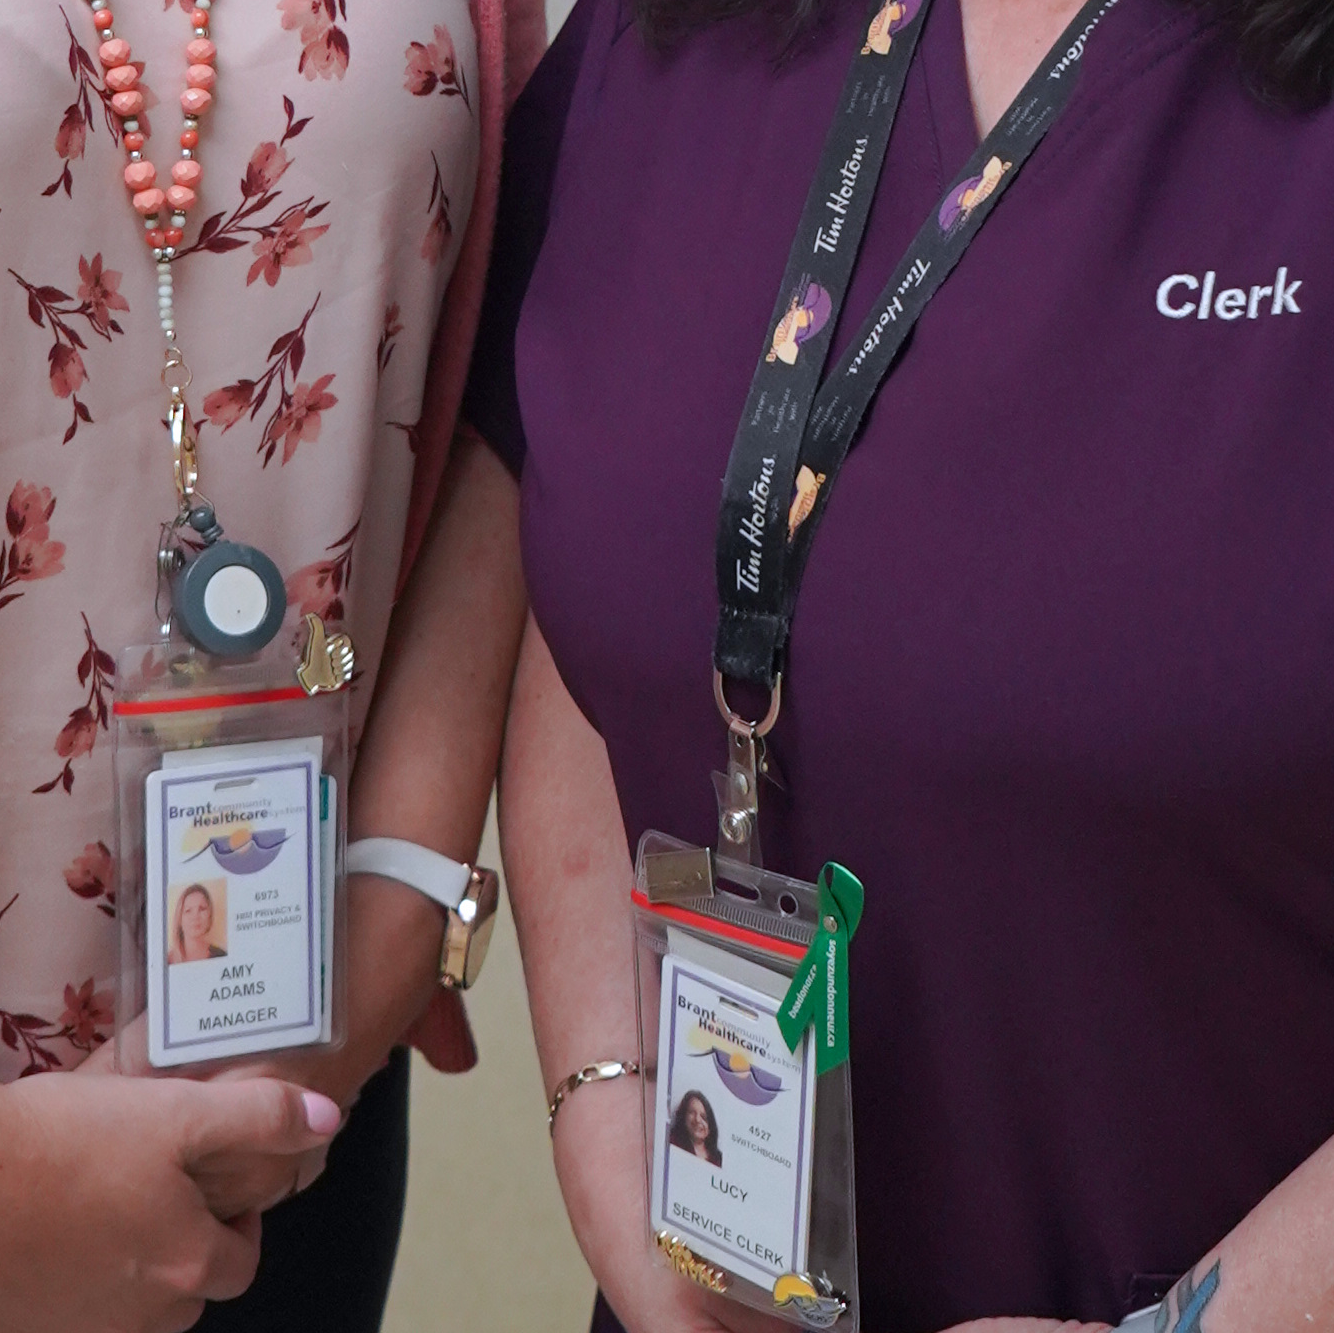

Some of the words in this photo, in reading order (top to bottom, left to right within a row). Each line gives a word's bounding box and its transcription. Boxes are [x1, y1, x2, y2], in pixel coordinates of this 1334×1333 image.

[826, 137, 868, 215] Hortons
[814, 217, 845, 253] Tim
[898, 259, 931, 295] Tim
[1156, 266, 1303, 321] Clerk
[846, 296, 904, 376] Hortons
[738, 455, 776, 547] Hortons
[736, 546, 763, 593] Tim
[169, 801, 212, 819] Brant
[213, 798, 272, 812] community
[193, 808, 269, 828] Healthcare
[236, 914, 302, 932] SWITCHBOARD
[255, 906, 292, 918] PRIVACY
[221, 963, 255, 980] AMY
[209, 981, 266, 1001] ADAMS
[198, 1006, 278, 1031] MANAGER
[678, 994, 717, 1023] Brant
[716, 1017, 771, 1050] community
[698, 1016, 767, 1058] Healthcare
[730, 1133, 792, 1169] SWITCHBOARD
[710, 1174, 748, 1203] LUCY
[673, 1201, 732, 1243] SERVICE
[736, 1234, 785, 1269] CLERK
